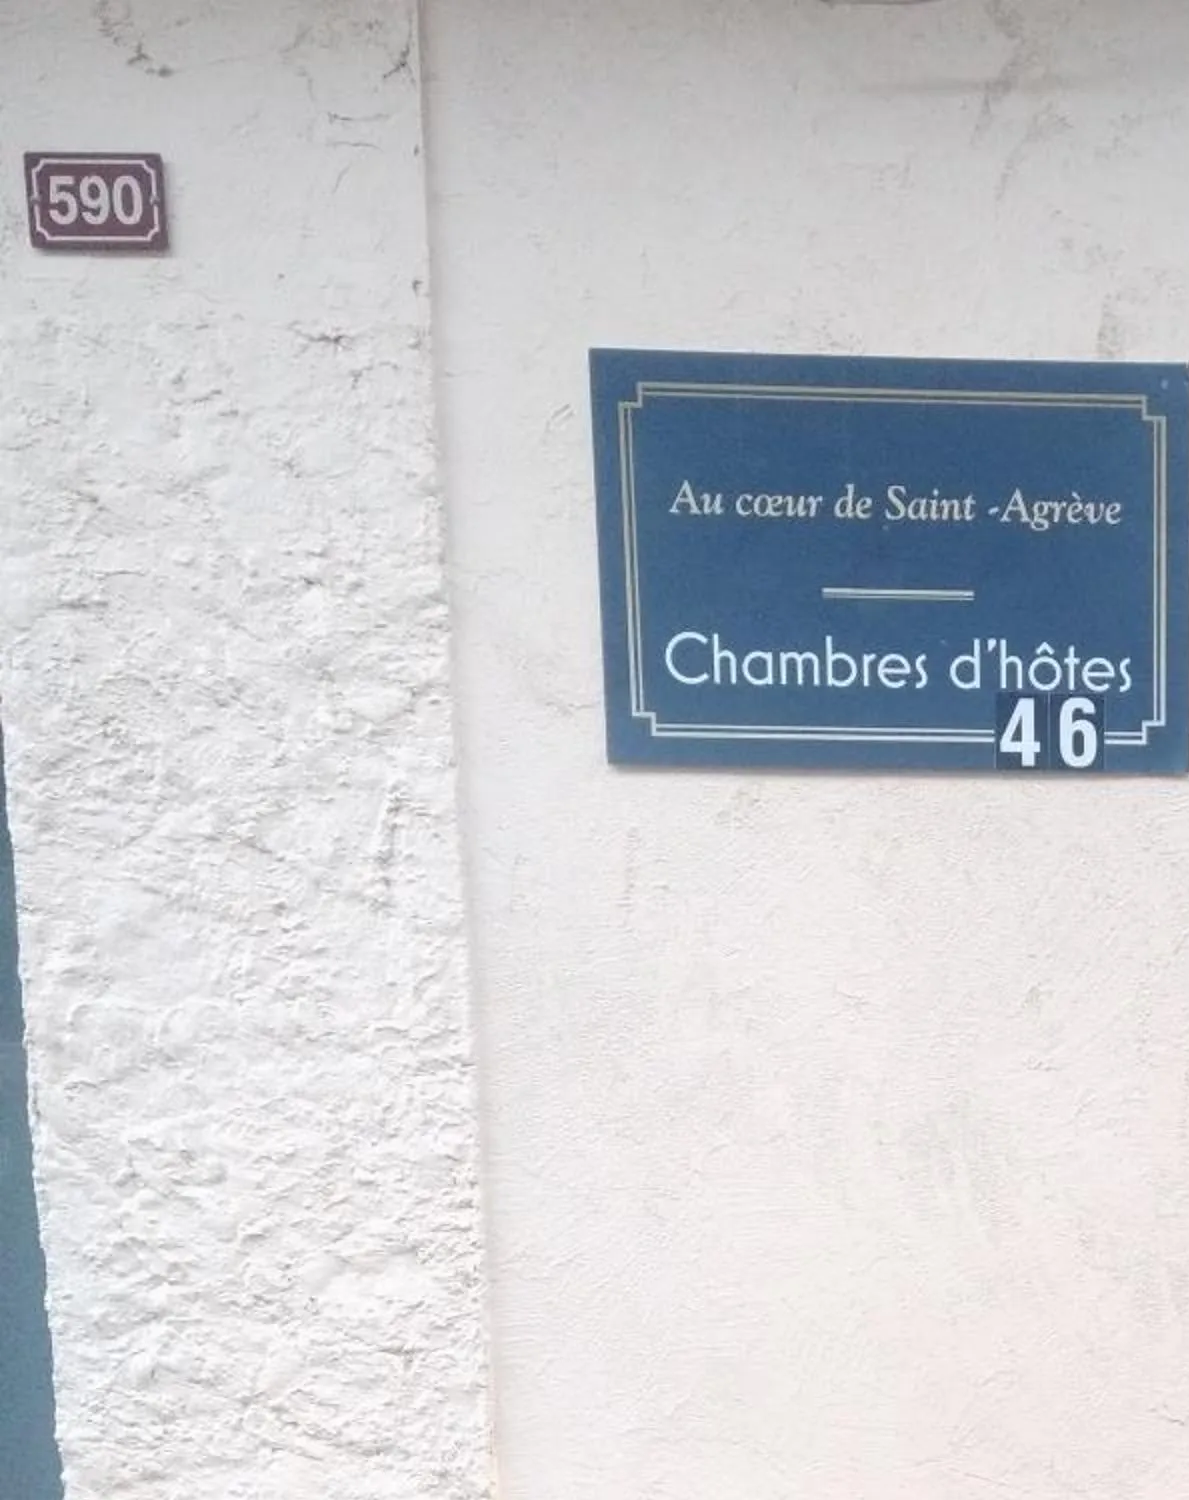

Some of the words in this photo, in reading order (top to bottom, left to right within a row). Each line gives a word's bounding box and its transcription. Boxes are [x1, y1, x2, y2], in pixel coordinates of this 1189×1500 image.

[48, 174, 144, 226] 590
[668, 479, 724, 515] Au
[735, 492, 824, 517] cœur
[833, 483, 874, 519] de
[884, 484, 977, 523] Saint
[664, 630, 929, 689] Chambres
[950, 637, 1133, 693] d'hôtes
[1000, 697, 1098, 769] 46
